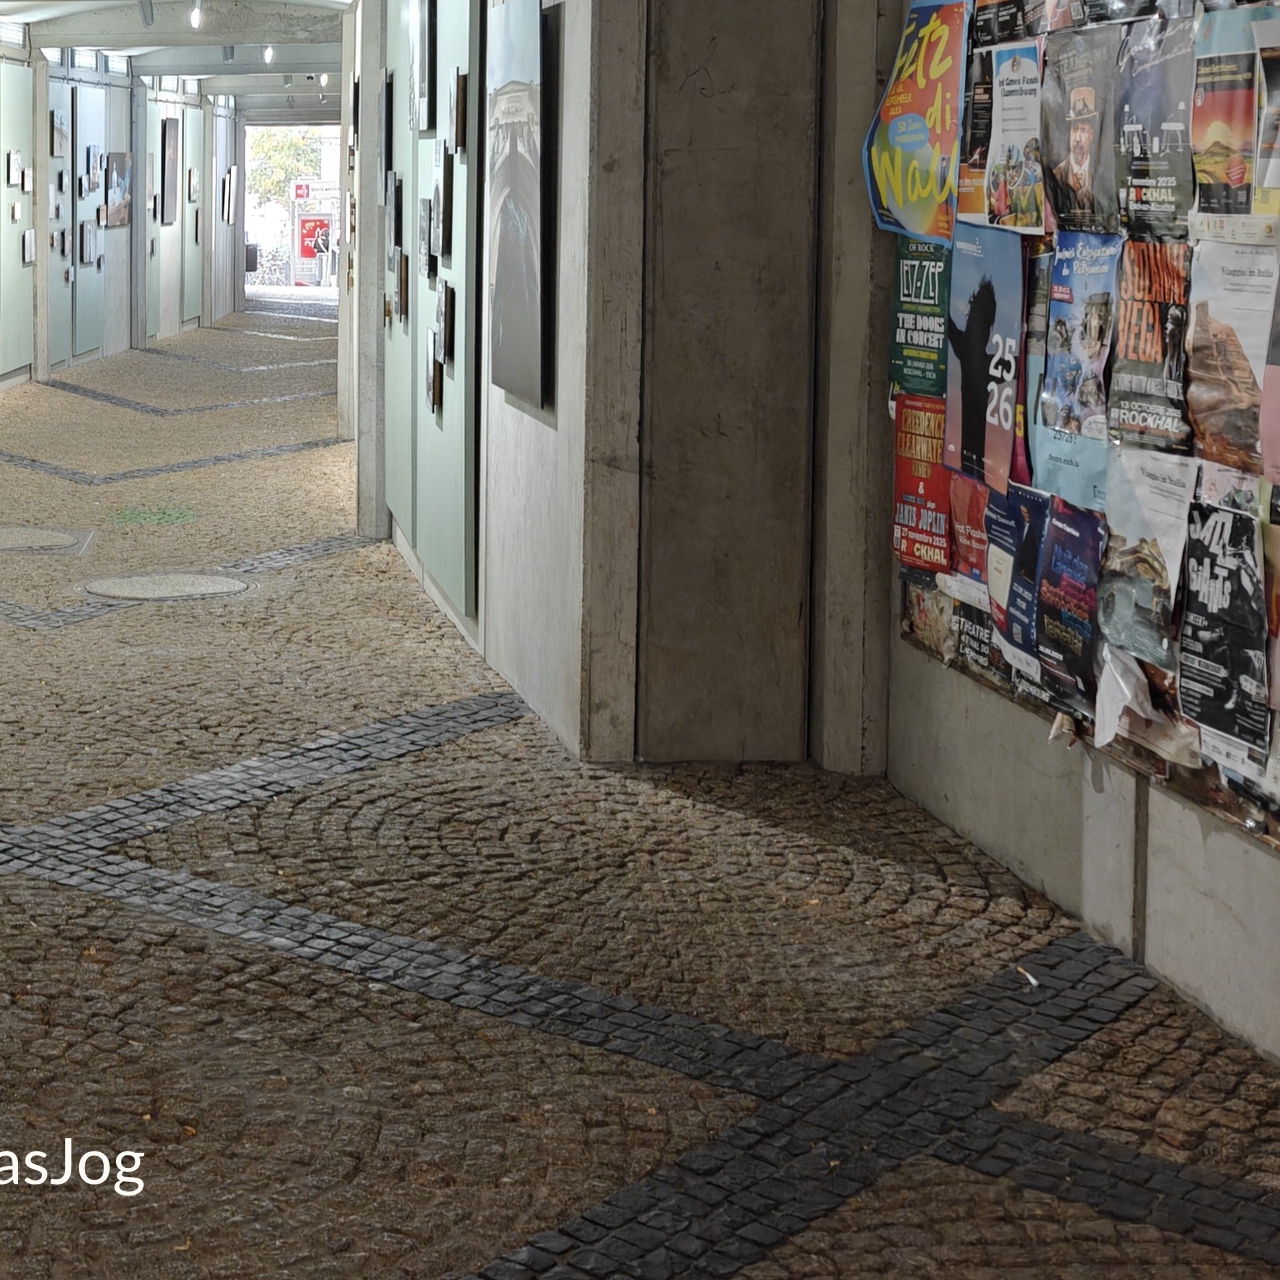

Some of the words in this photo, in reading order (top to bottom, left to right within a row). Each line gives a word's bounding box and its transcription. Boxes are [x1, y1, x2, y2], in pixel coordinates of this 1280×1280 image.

[926, 81, 951, 135] di
[871, 140, 959, 209] Wall
[896, 312, 916, 330] THE
[916, 314, 945, 334] DOORS
[895, 327, 906, 343] IN
[906, 329, 945, 350] CONCERT
[988, 332, 1016, 383] 25
[985, 380, 1013, 432] 26
[1120, 409, 1180, 433] ROCKHAL
[897, 432, 943, 464] CLEARWATE
[917, 481, 925, 494] &
[918, 507, 946, 536] JOPLIN
[932, 537, 947, 547] 2025
